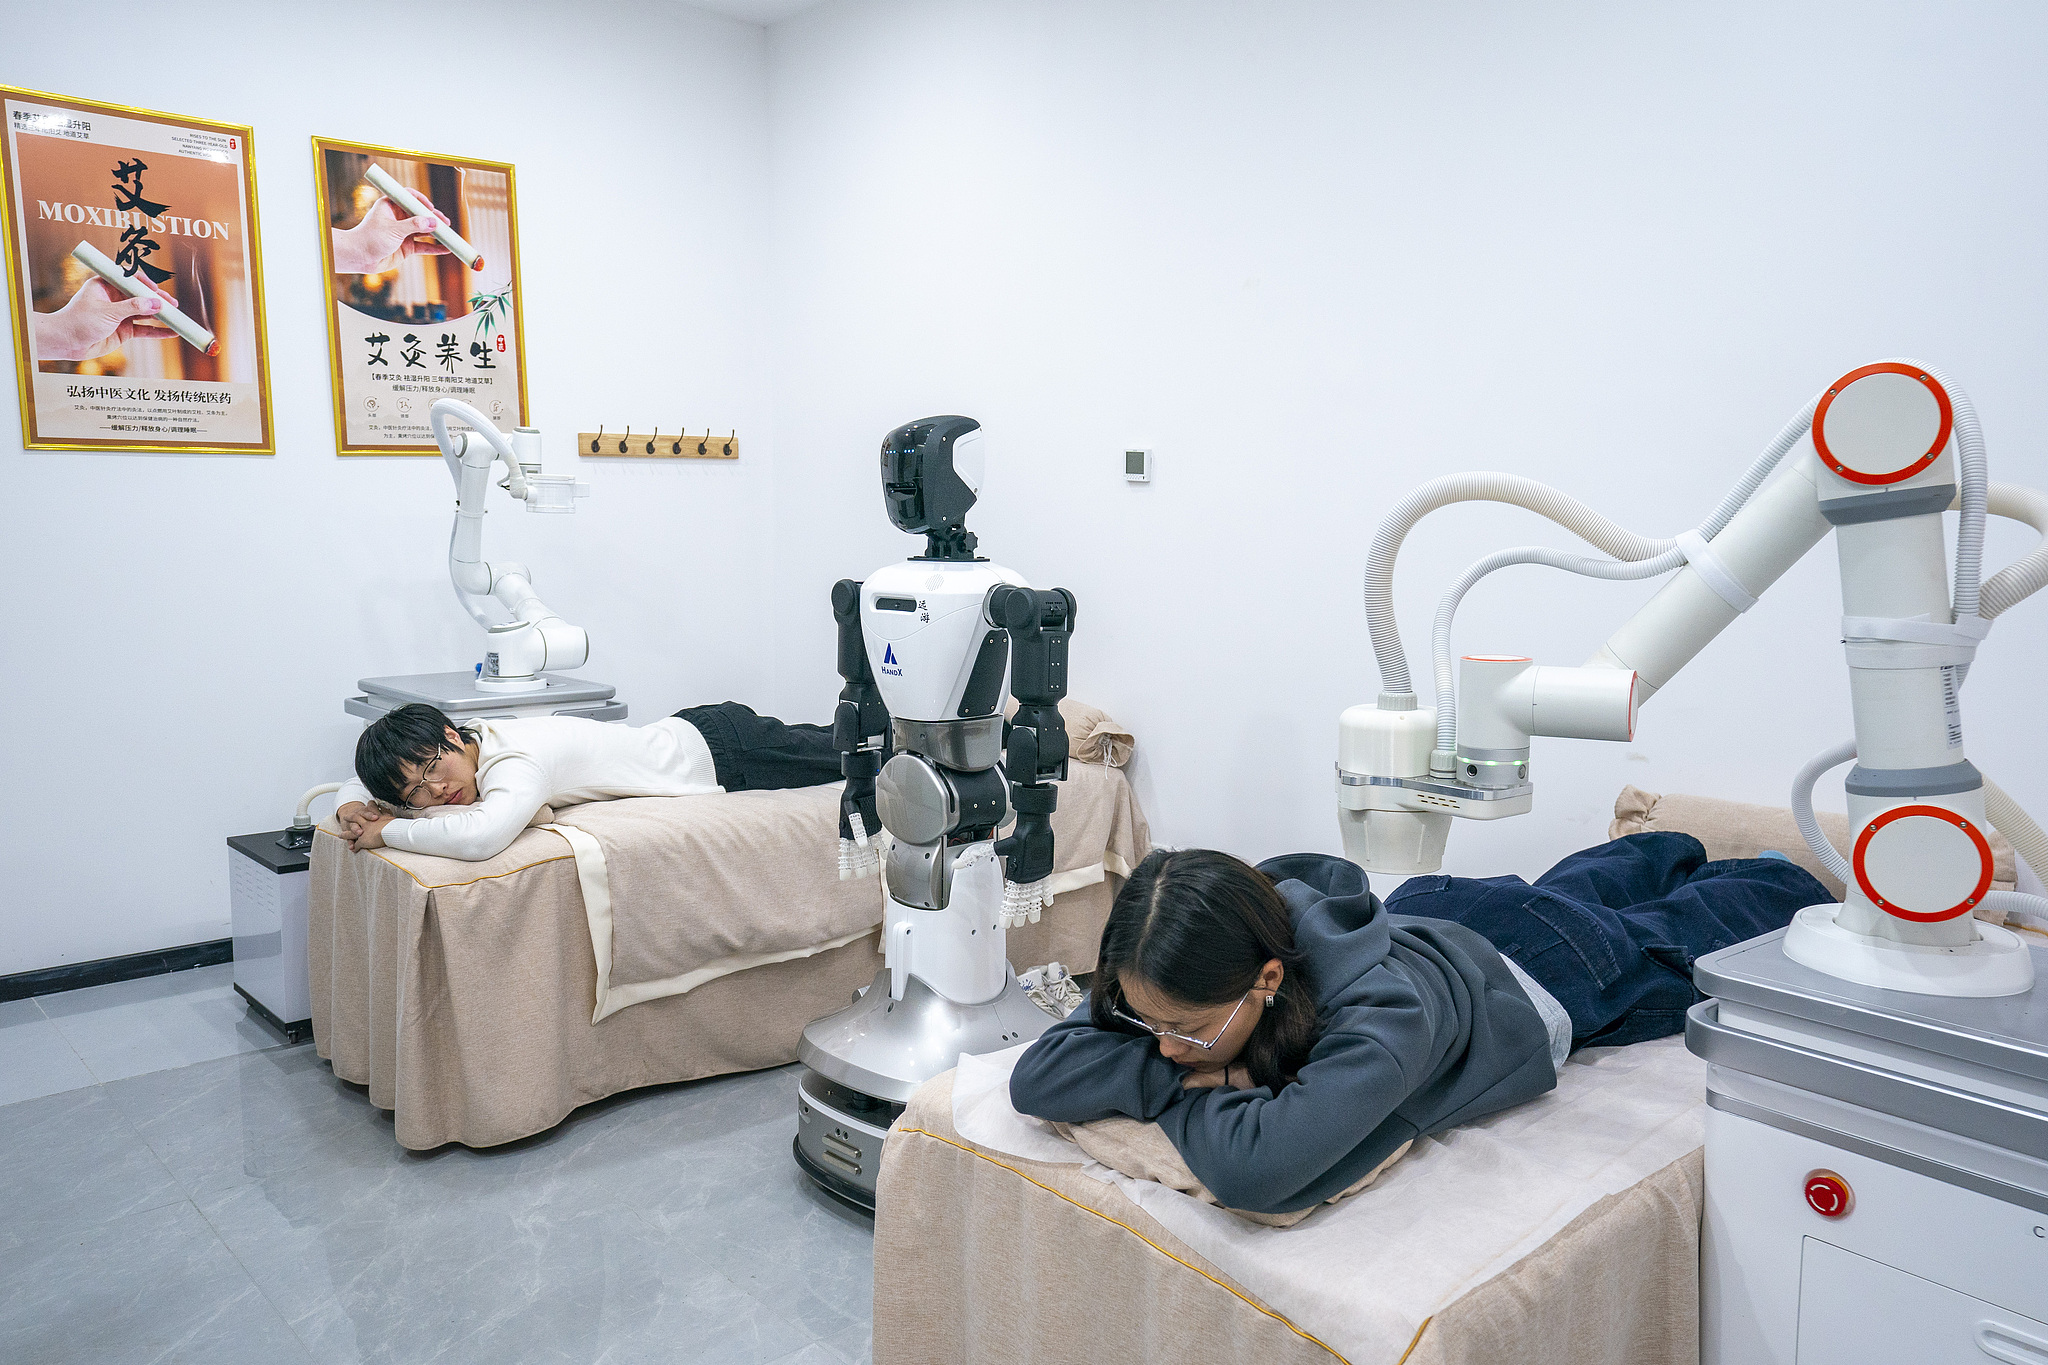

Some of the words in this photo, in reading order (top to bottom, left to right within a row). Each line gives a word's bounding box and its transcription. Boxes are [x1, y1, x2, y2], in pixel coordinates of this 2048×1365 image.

[37, 200, 229, 241] MOXIBUSTION
[364, 331, 496, 374] 艾灸养生
[66, 385, 150, 401] 弘扬中医文化
[154, 389, 231, 405] 发扬传统医药
